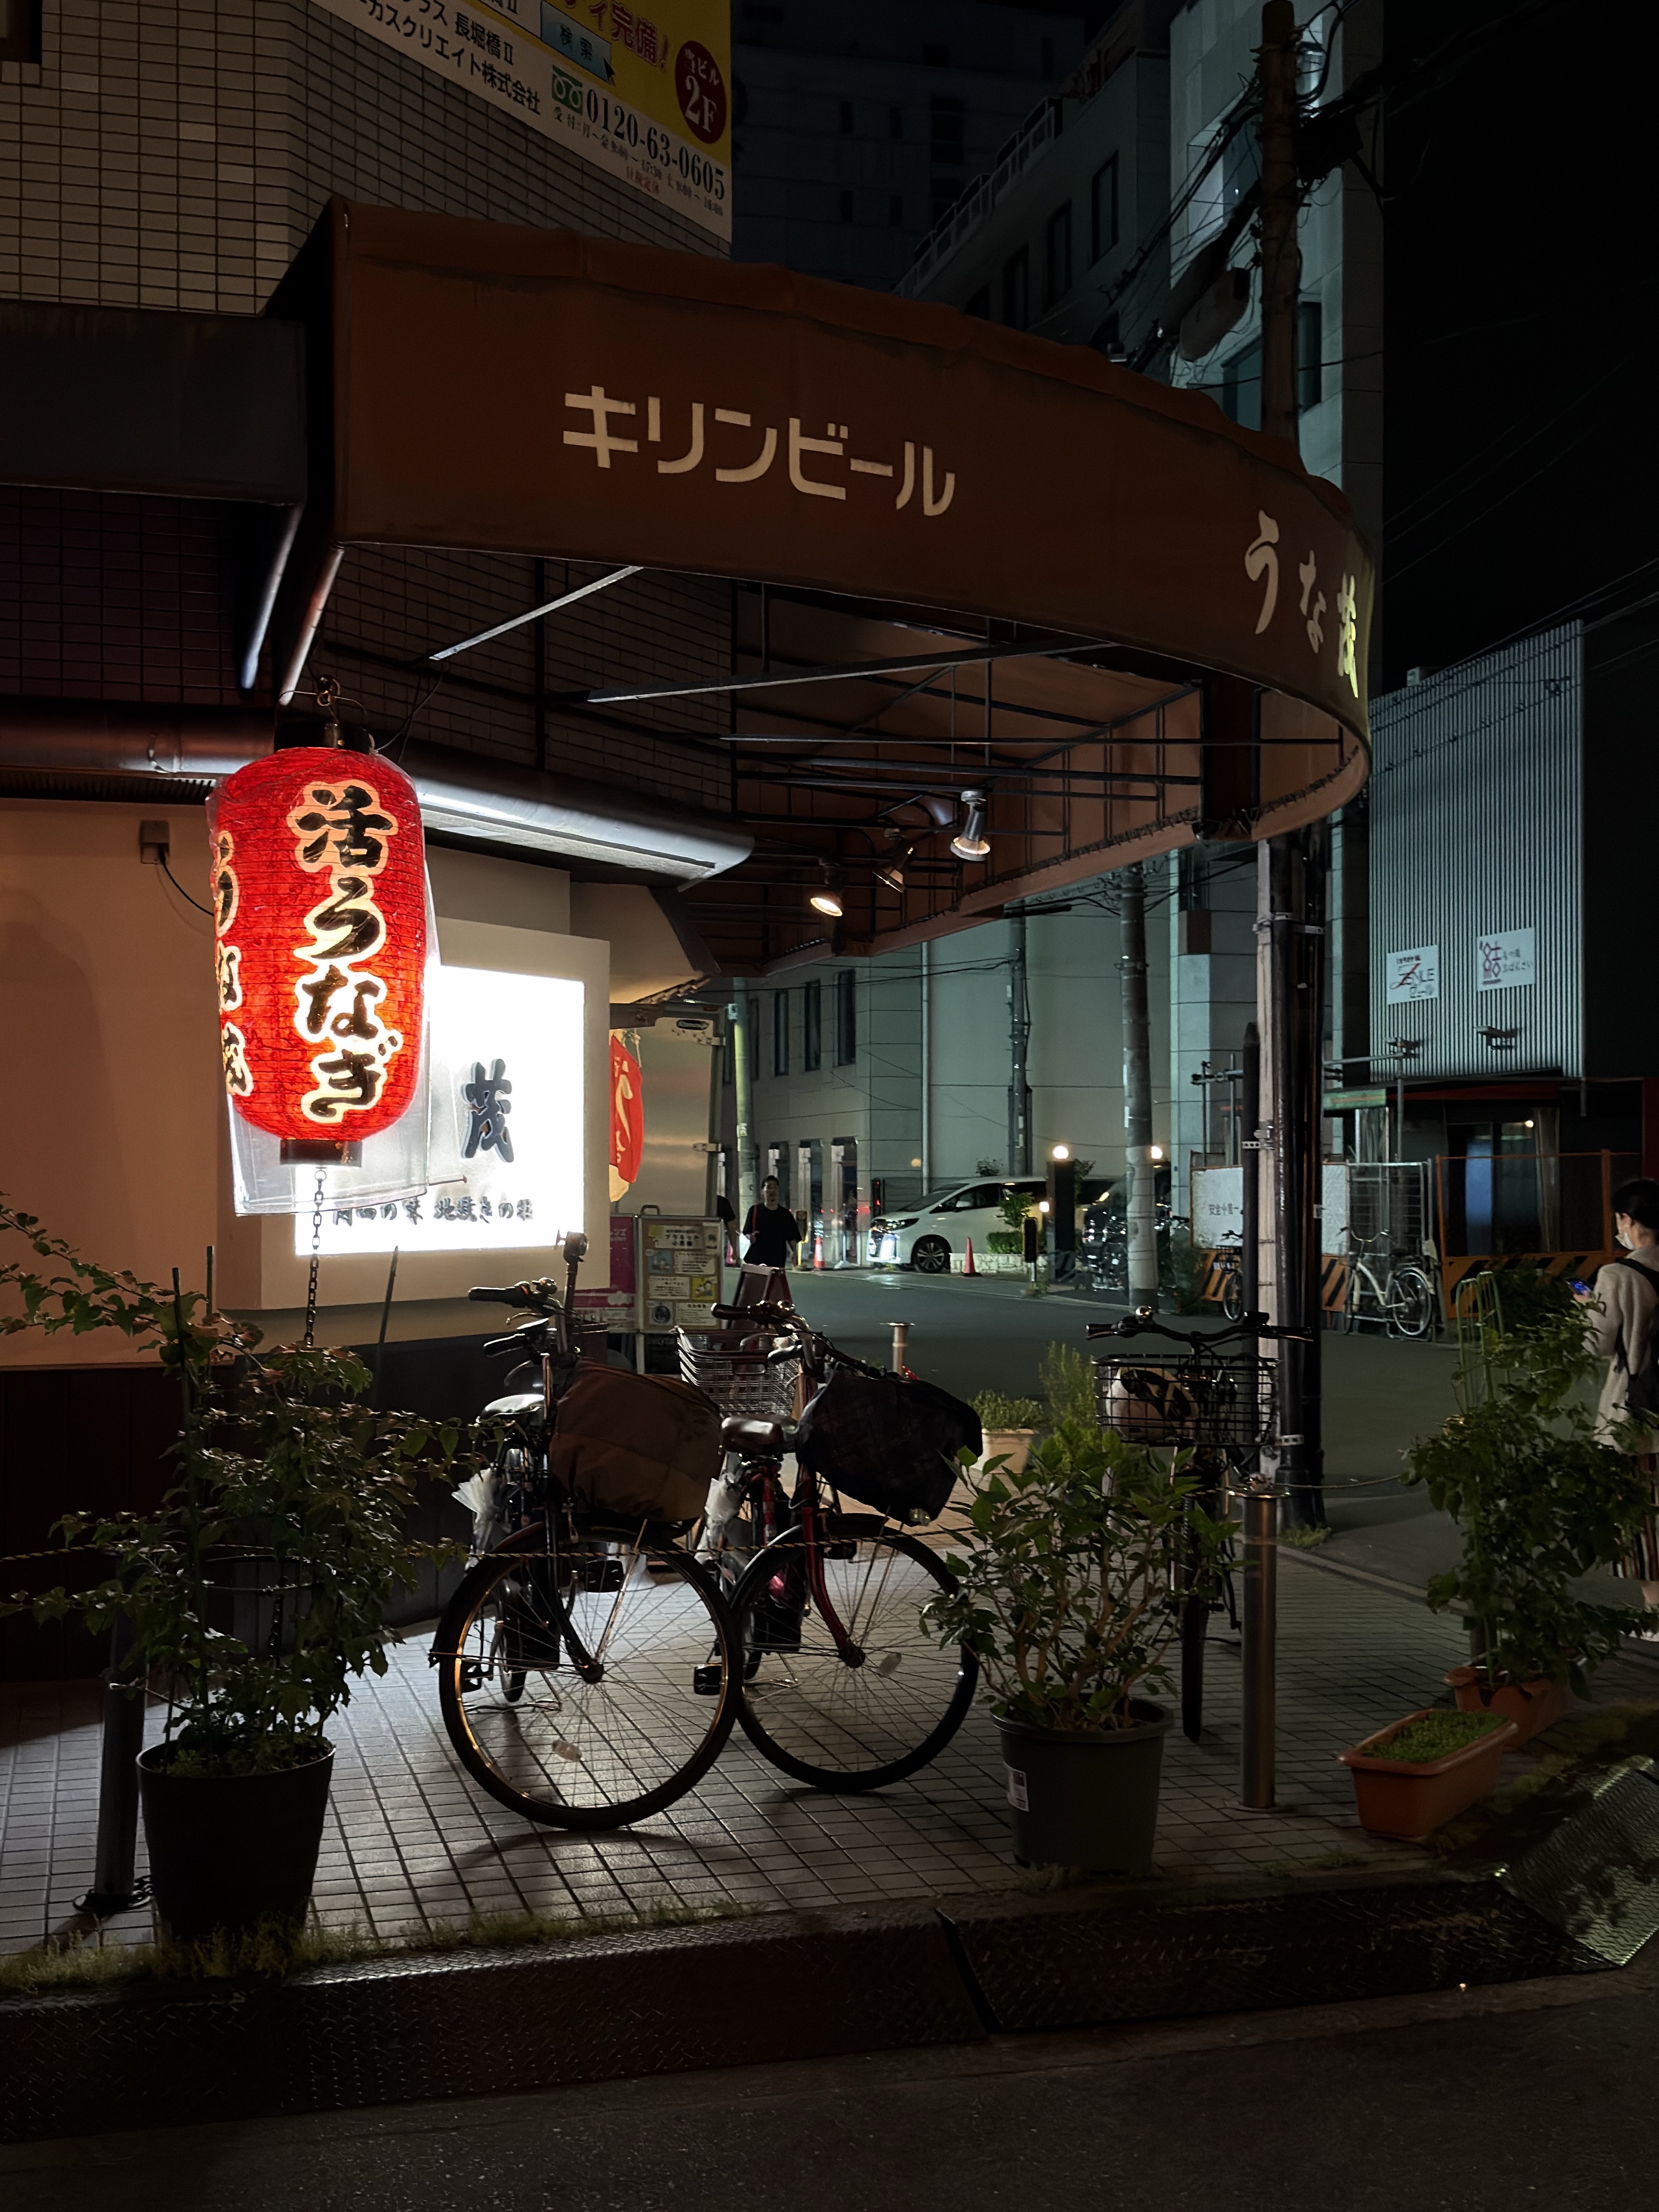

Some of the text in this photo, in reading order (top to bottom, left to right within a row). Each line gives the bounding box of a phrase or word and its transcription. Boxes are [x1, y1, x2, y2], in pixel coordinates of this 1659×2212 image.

[360, 0, 541, 115] カスクリエイト株式会社
[560, 25, 593, 62] 検索
[587, 89, 724, 200] 0120-63-0605
[684, 75, 717, 133] 2F
[563, 385, 955, 516] キリンビール
[295, 784, 398, 1118] 活うなぎ
